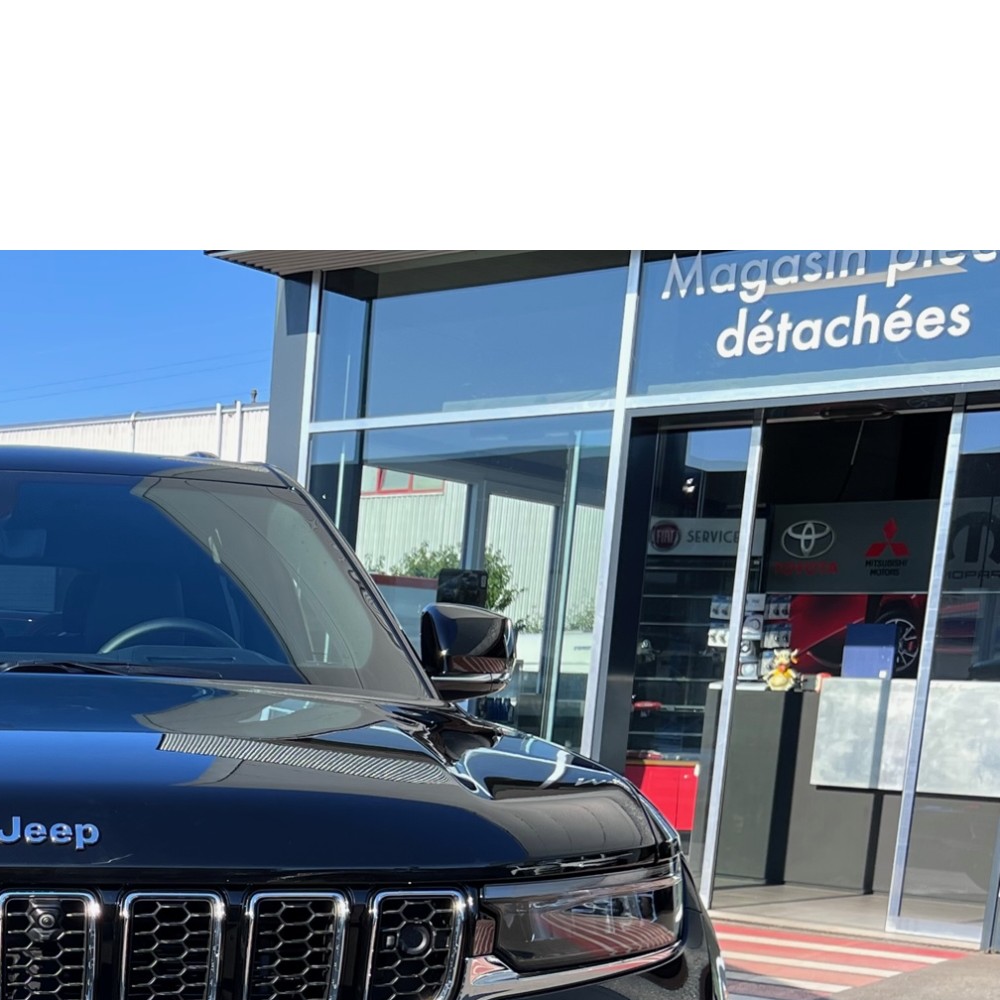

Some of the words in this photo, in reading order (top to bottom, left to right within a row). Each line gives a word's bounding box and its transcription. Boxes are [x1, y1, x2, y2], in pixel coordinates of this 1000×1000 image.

[661, 250, 866, 303] Magasin
[716, 294, 971, 358] détachées
[656, 528, 676, 544] FIAT
[686, 529, 739, 544] SERVICE
